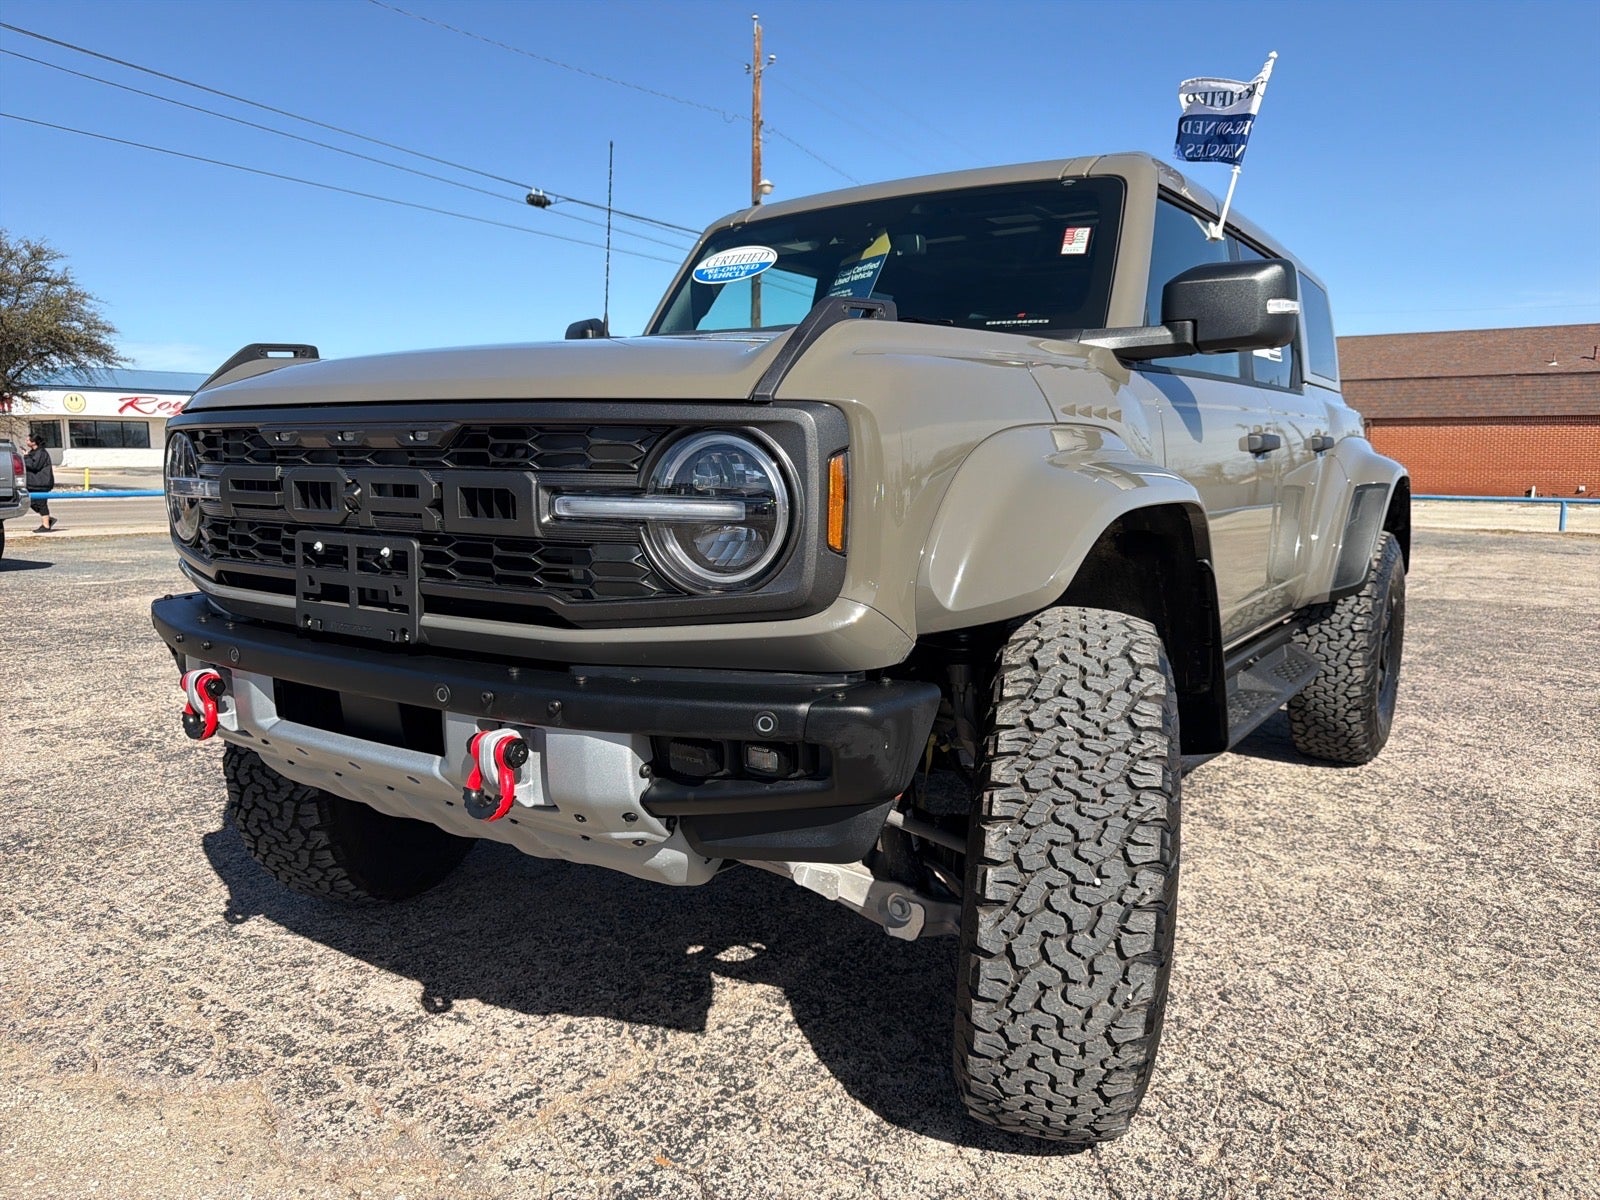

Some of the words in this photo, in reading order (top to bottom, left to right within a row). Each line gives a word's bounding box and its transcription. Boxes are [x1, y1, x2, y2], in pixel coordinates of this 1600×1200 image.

[705, 252, 770, 268] CERTIFIED
[852, 260, 881, 274] Certified
[703, 263, 760, 276] PRE-OWNED
[708, 271, 748, 280] VEHICLE
[834, 275, 851, 286] Used
[850, 270, 874, 282] Vehicle
[220, 465, 543, 537] FORD
